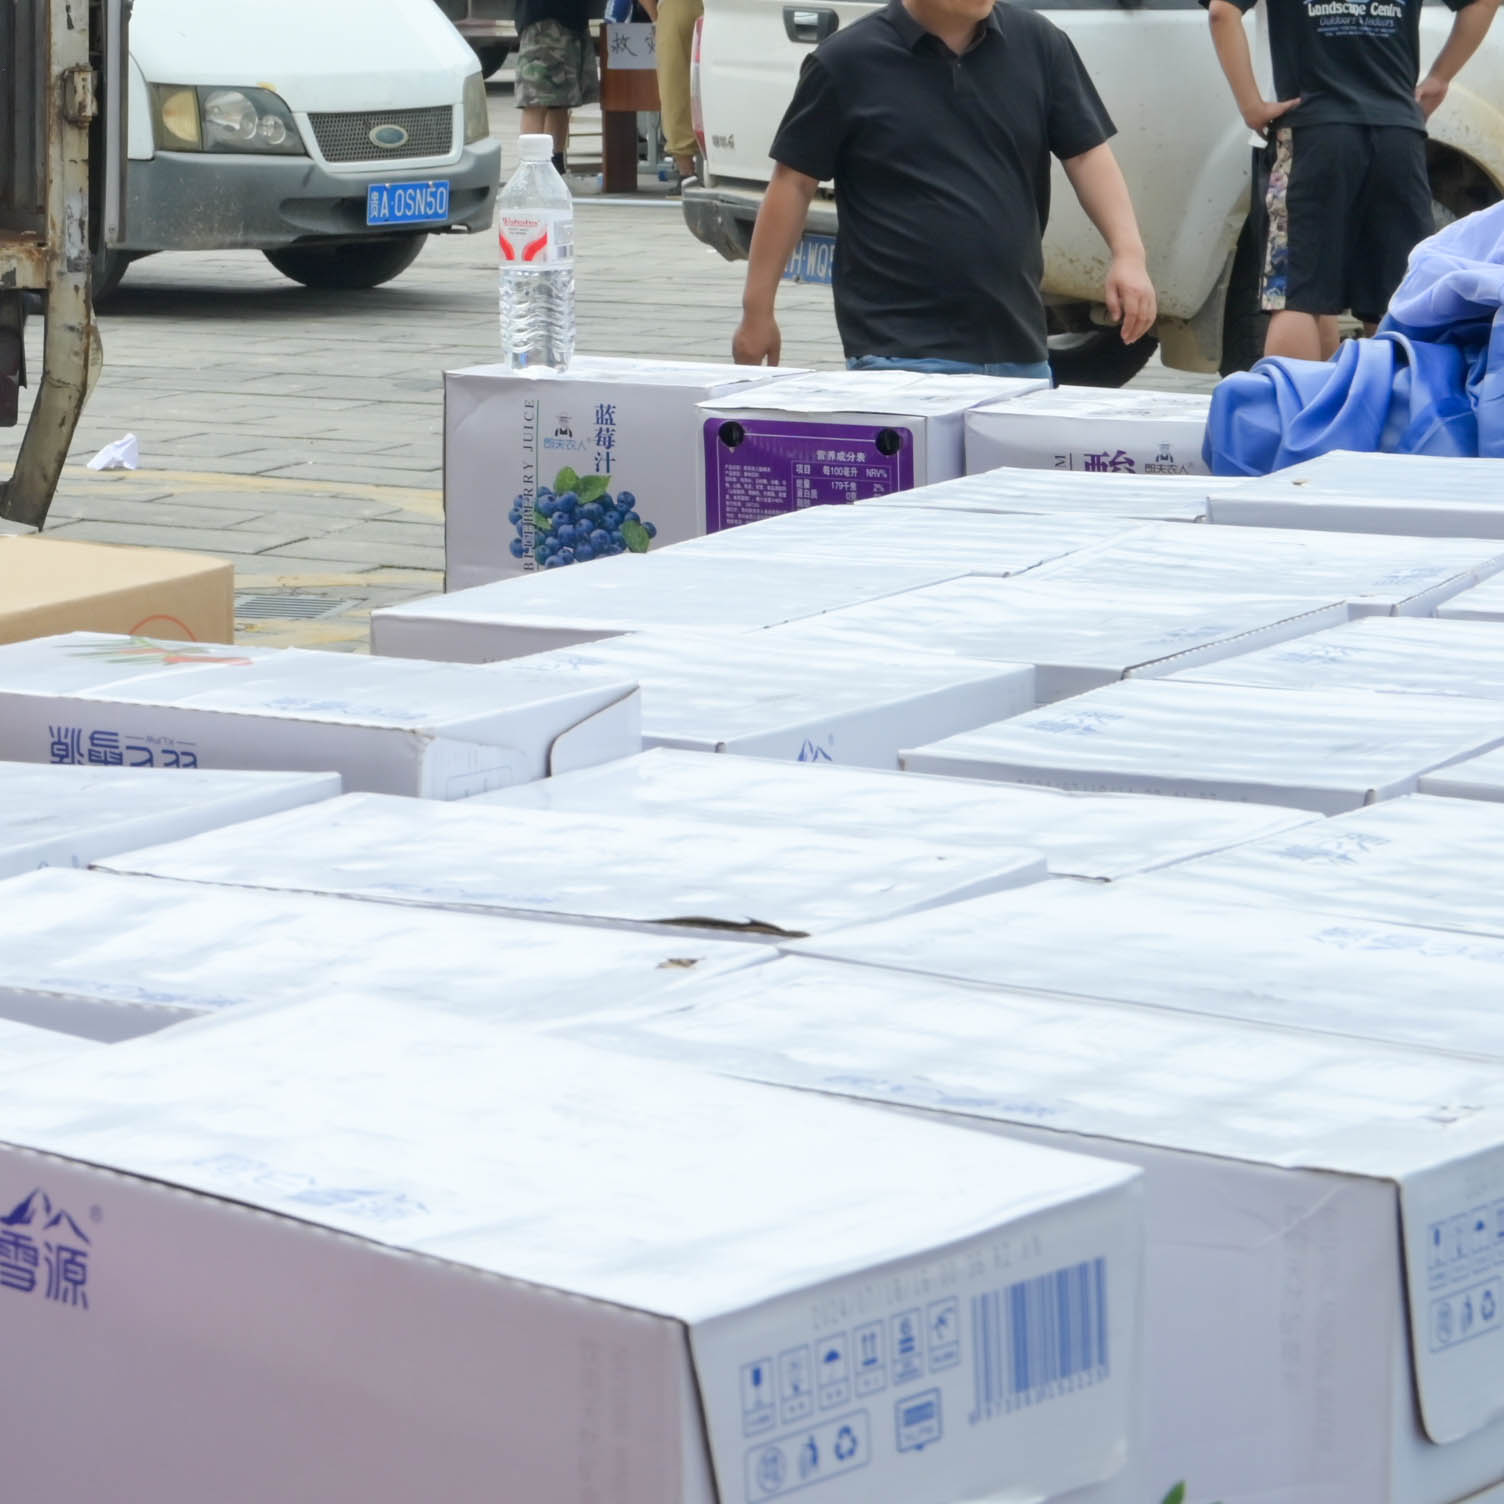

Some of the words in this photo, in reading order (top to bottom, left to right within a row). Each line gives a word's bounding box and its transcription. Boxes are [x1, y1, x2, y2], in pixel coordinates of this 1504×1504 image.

[1308, 2, 1366, 16] Landscape
[522, 399, 535, 453] JUICE
[594, 404, 617, 473] 蓝莓汁
